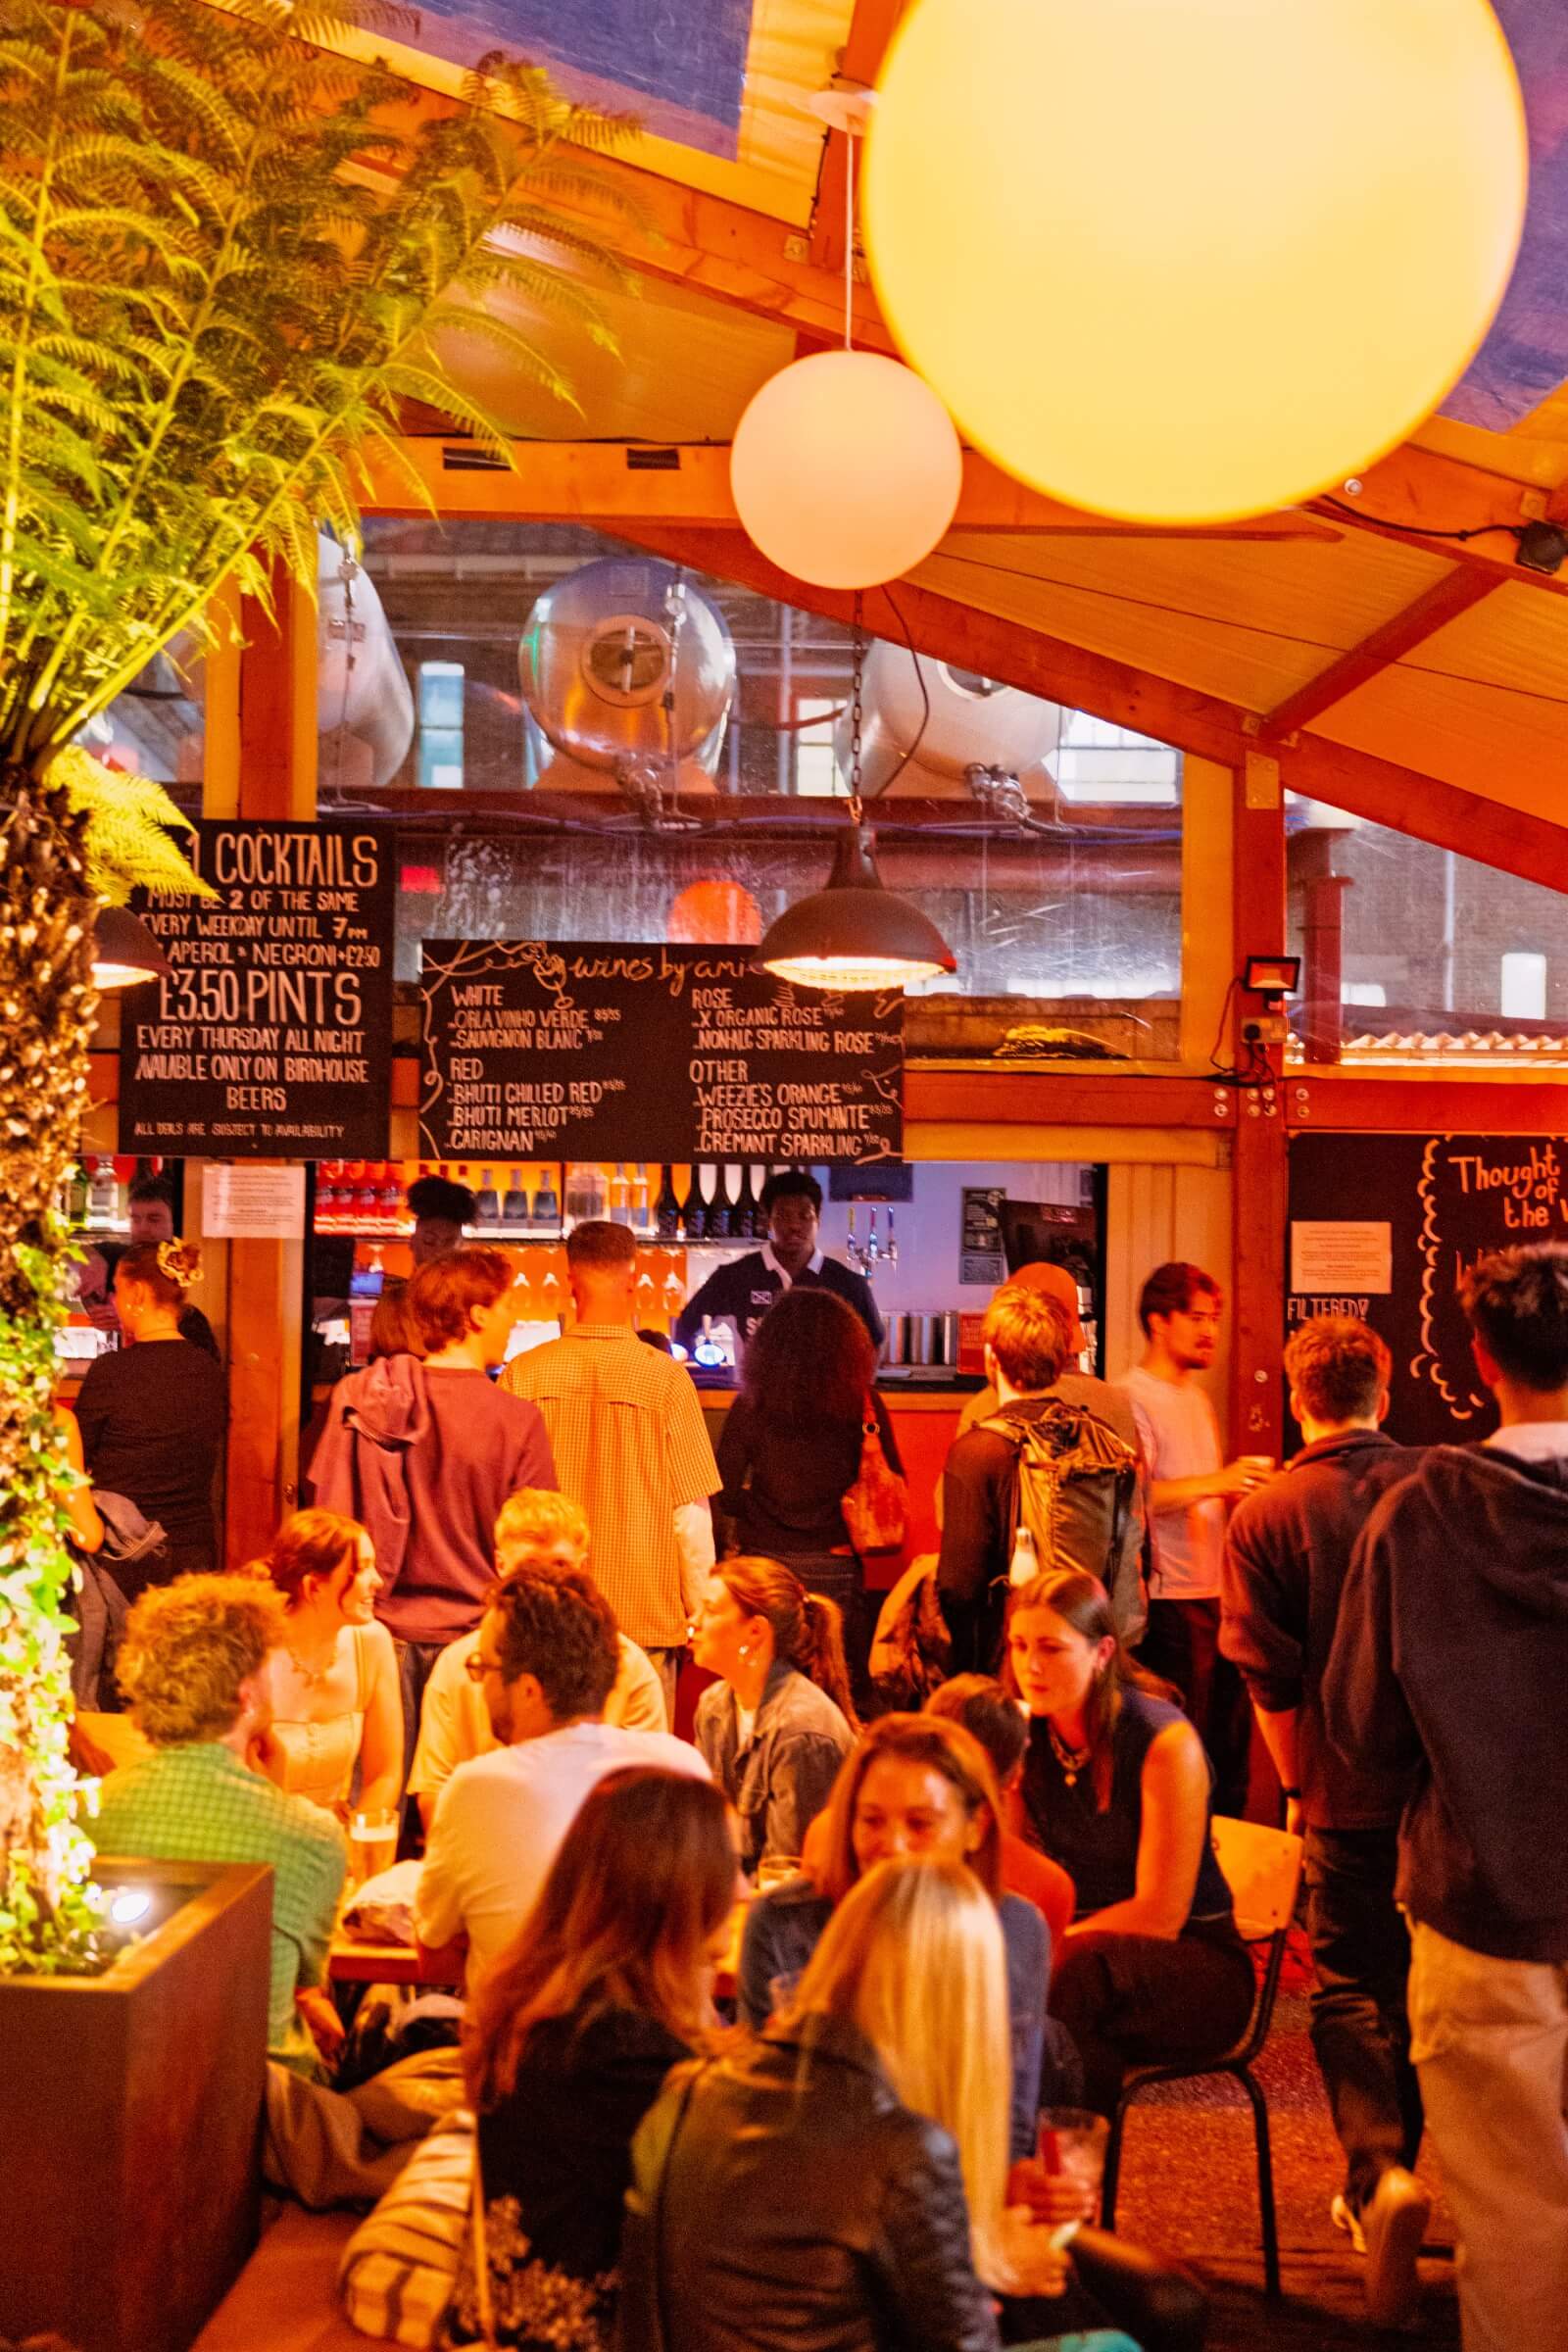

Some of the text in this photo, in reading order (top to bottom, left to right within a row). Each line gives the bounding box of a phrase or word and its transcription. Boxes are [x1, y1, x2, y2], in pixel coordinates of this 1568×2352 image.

[215, 832, 379, 888] COCKTAILS
[228, 889, 244, 909] 2
[250, 889, 273, 910] OF
[278, 890, 314, 911] THE
[317, 892, 360, 912] SAME
[197, 914, 266, 938] WEEKDAY
[269, 917, 323, 939] UNTIL
[167, 941, 235, 964] APEROL
[252, 943, 337, 966] NEGRONI
[570, 956, 655, 981] wines
[658, 946, 686, 997] by
[160, 968, 362, 1026] £3.50 PINTS
[451, 984, 505, 1007] WHITE
[691, 988, 733, 1009] ROSE
[539, 1009, 589, 1029] VERDE
[715, 1005, 778, 1027] ORGANIC
[781, 1005, 823, 1026] ROSE
[137, 1024, 366, 1054] EVERY THURSDAY ALL NIGHT
[535, 1030, 583, 1050] BLANC
[756, 1029, 830, 1053] SPARKLING
[834, 1030, 875, 1054] ROSE
[210, 1054, 252, 1081] ONLY
[254, 1056, 278, 1082] ON
[284, 1057, 369, 1083] BIRDHOUSE
[450, 1057, 484, 1081] RED
[689, 1059, 749, 1083] OTHER
[226, 1085, 287, 1111] BEERS
[505, 1082, 564, 1104] CHILLED
[568, 1082, 603, 1104] RED
[776, 1083, 843, 1105] ORANGE
[506, 1104, 568, 1127] MERLOT
[702, 1106, 782, 1130] PROSECCO
[787, 1104, 870, 1130] SPUMANTE
[134, 1121, 155, 1137] ALL
[450, 1128, 533, 1152] CARIGNAN
[779, 1133, 862, 1157] SPARKLING
[1447, 1143, 1561, 1199] Thought
[1535, 1176, 1559, 1205] of
[1503, 1197, 1550, 1228] the
